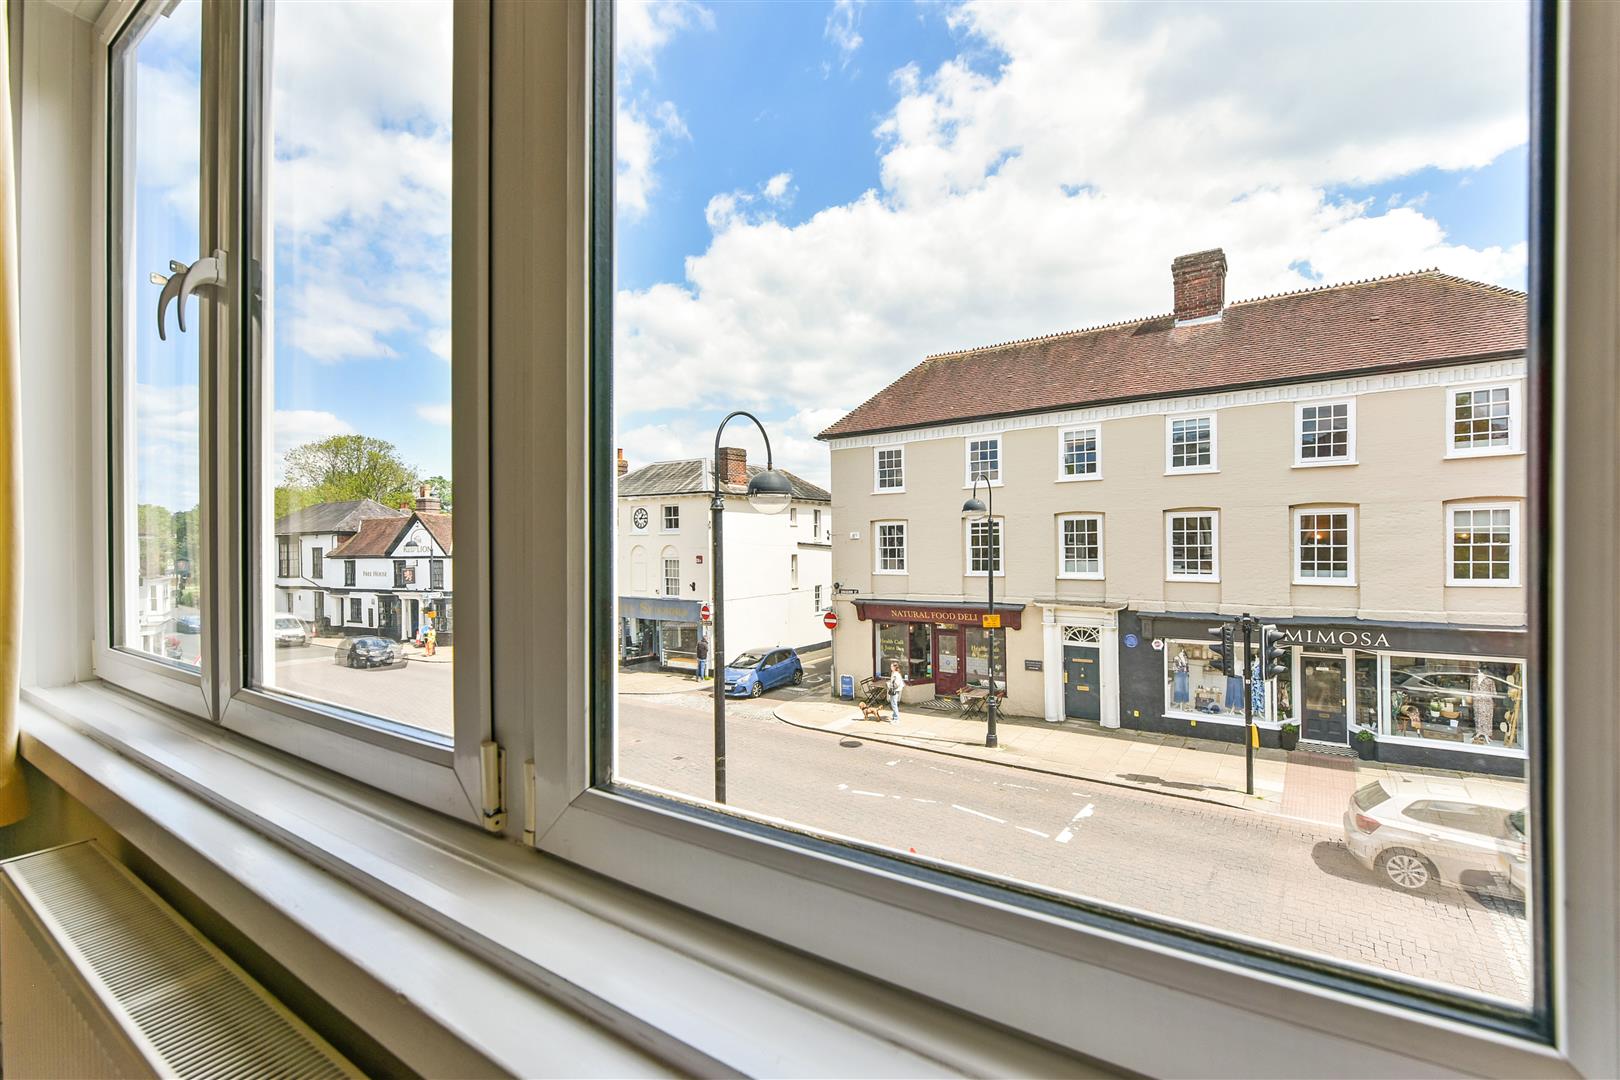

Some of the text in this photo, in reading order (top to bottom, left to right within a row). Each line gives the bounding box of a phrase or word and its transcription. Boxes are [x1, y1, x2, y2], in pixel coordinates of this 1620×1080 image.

[417, 545, 432, 553] LION
[891, 609, 930, 619] NATURAL
[931, 611, 956, 620] FOOD
[957, 613, 978, 621] DELI
[1283, 629, 1391, 647] MIMOSA
